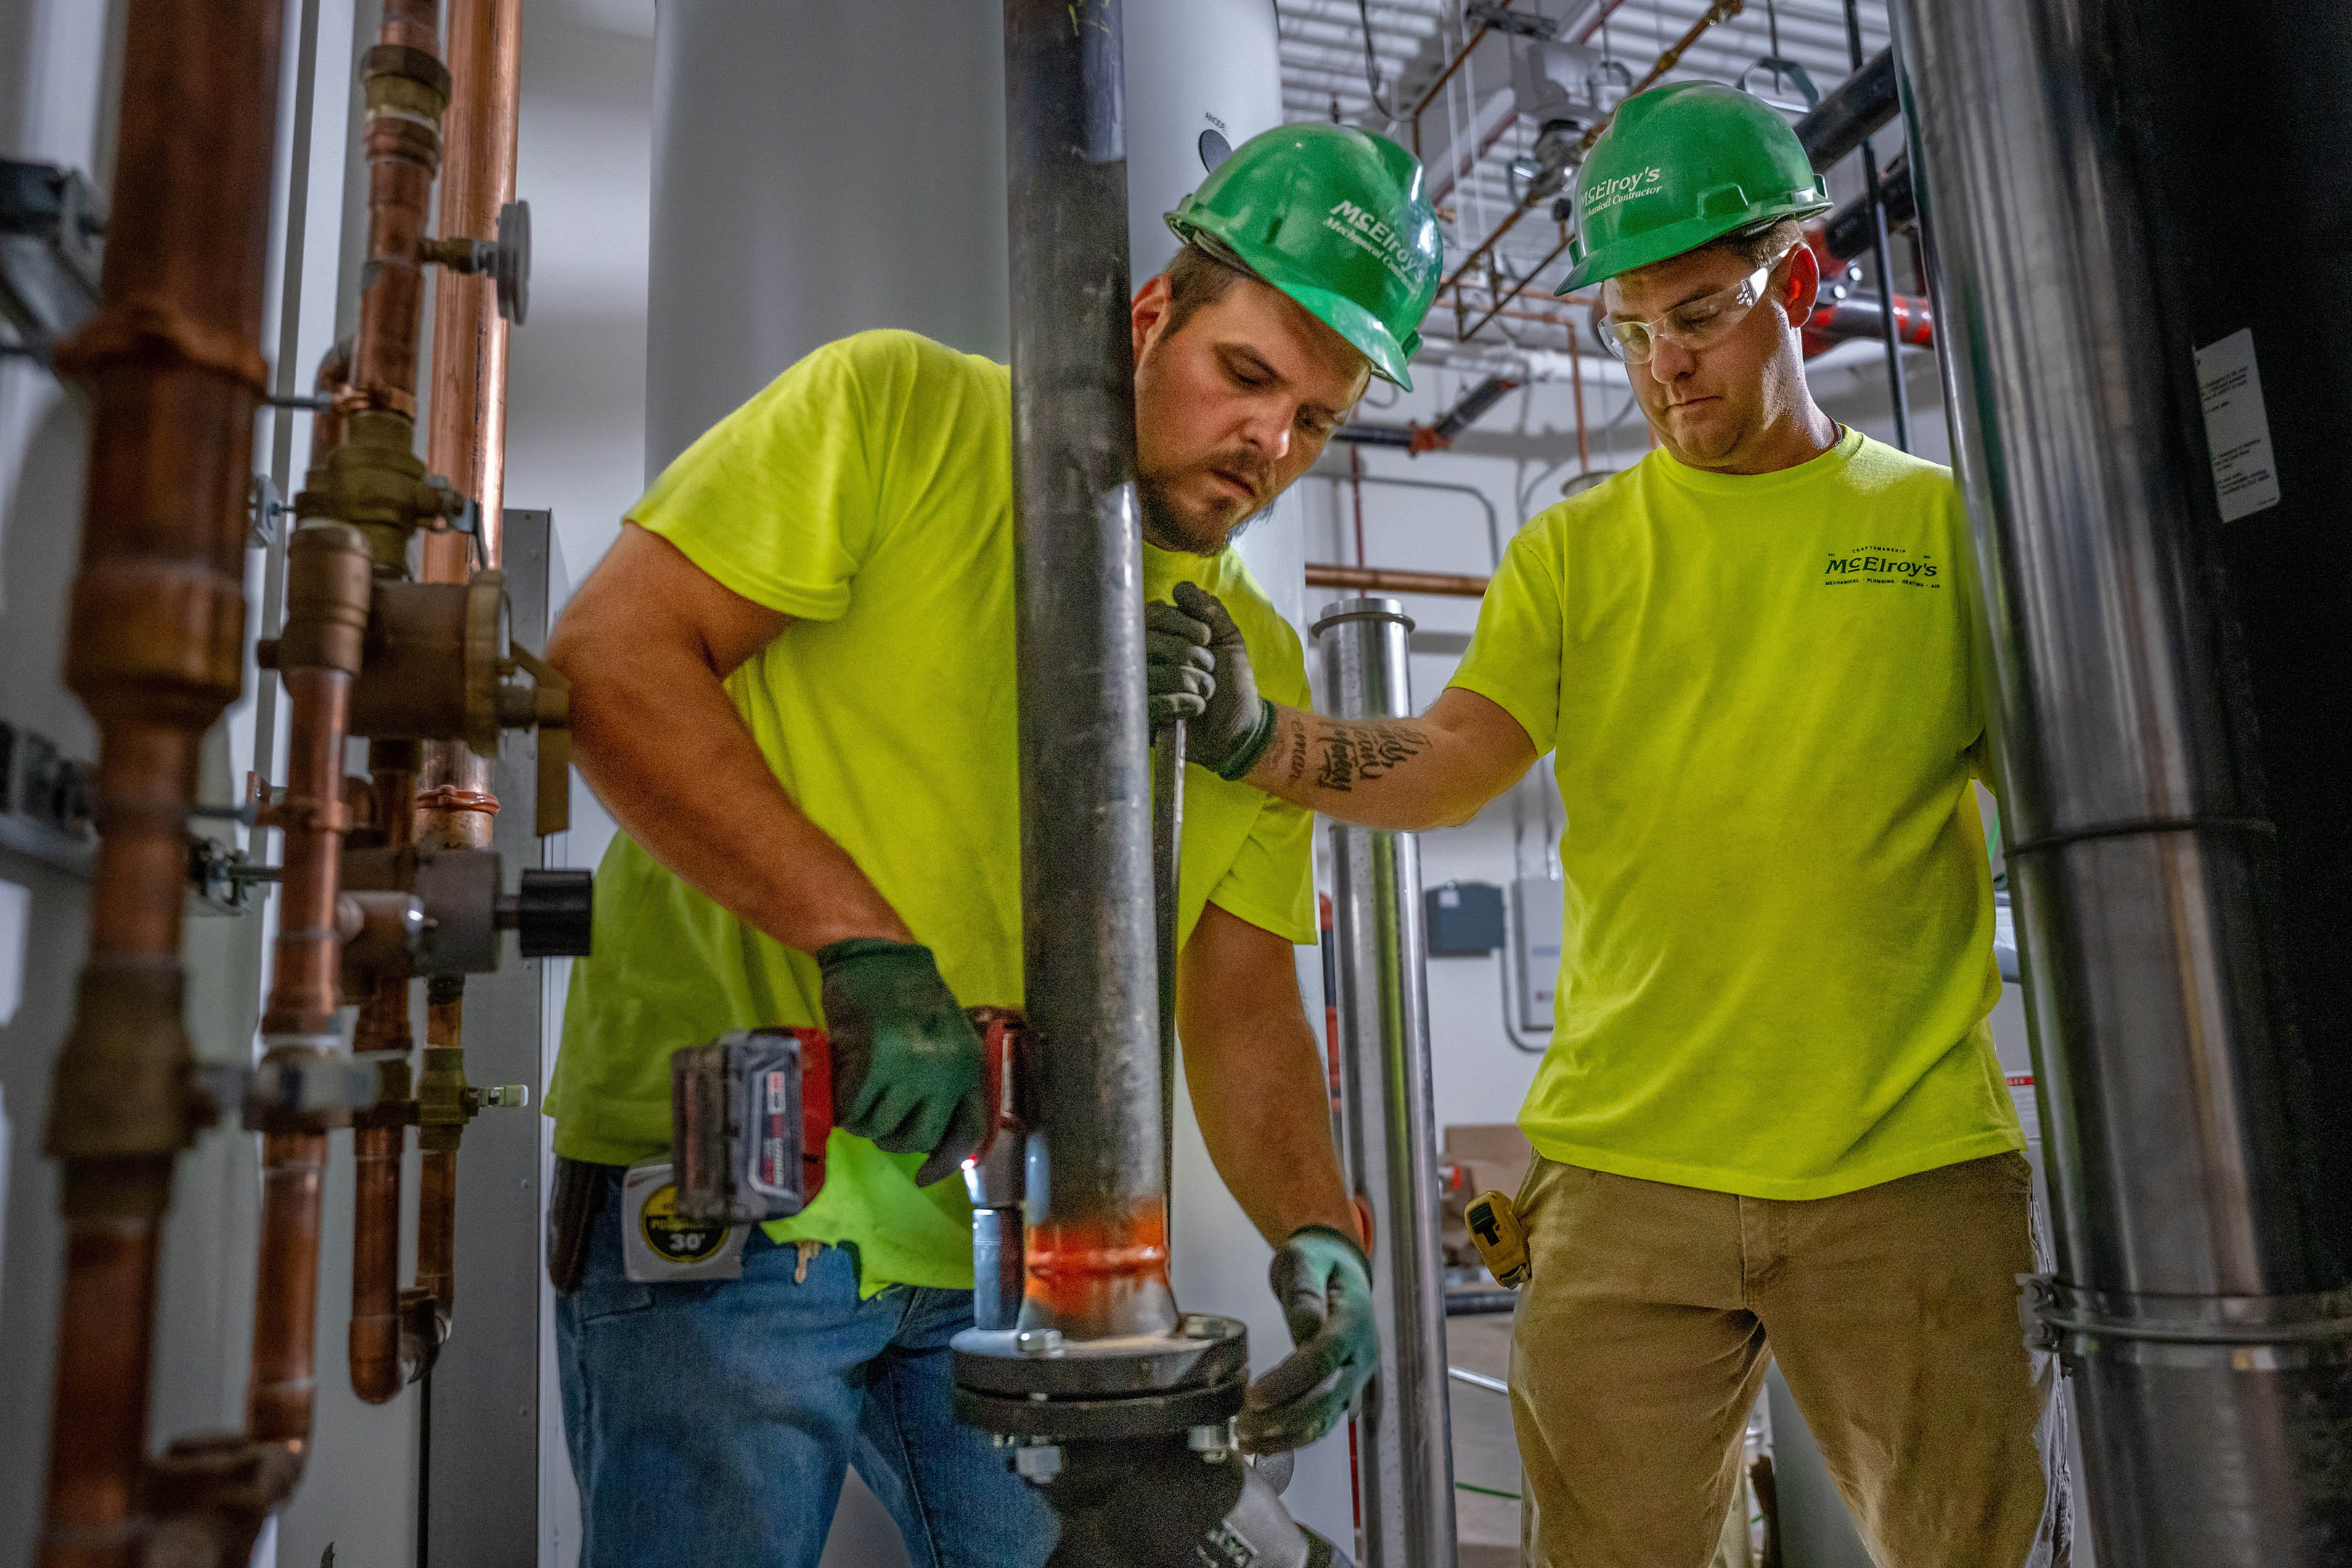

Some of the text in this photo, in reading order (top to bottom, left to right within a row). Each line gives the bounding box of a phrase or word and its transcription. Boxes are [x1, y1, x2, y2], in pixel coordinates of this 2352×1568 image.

[1205, 112, 1226, 132] ANODE
[1580, 166, 1661, 208] McElroy's
[1612, 185, 1663, 205] Contractor
[1323, 216, 1385, 260] Mechanical
[1329, 199, 1425, 283] McElroy's
[1852, 545, 1906, 554] CRAFTSMANSHIP
[1824, 557, 1938, 577] McElroy's
